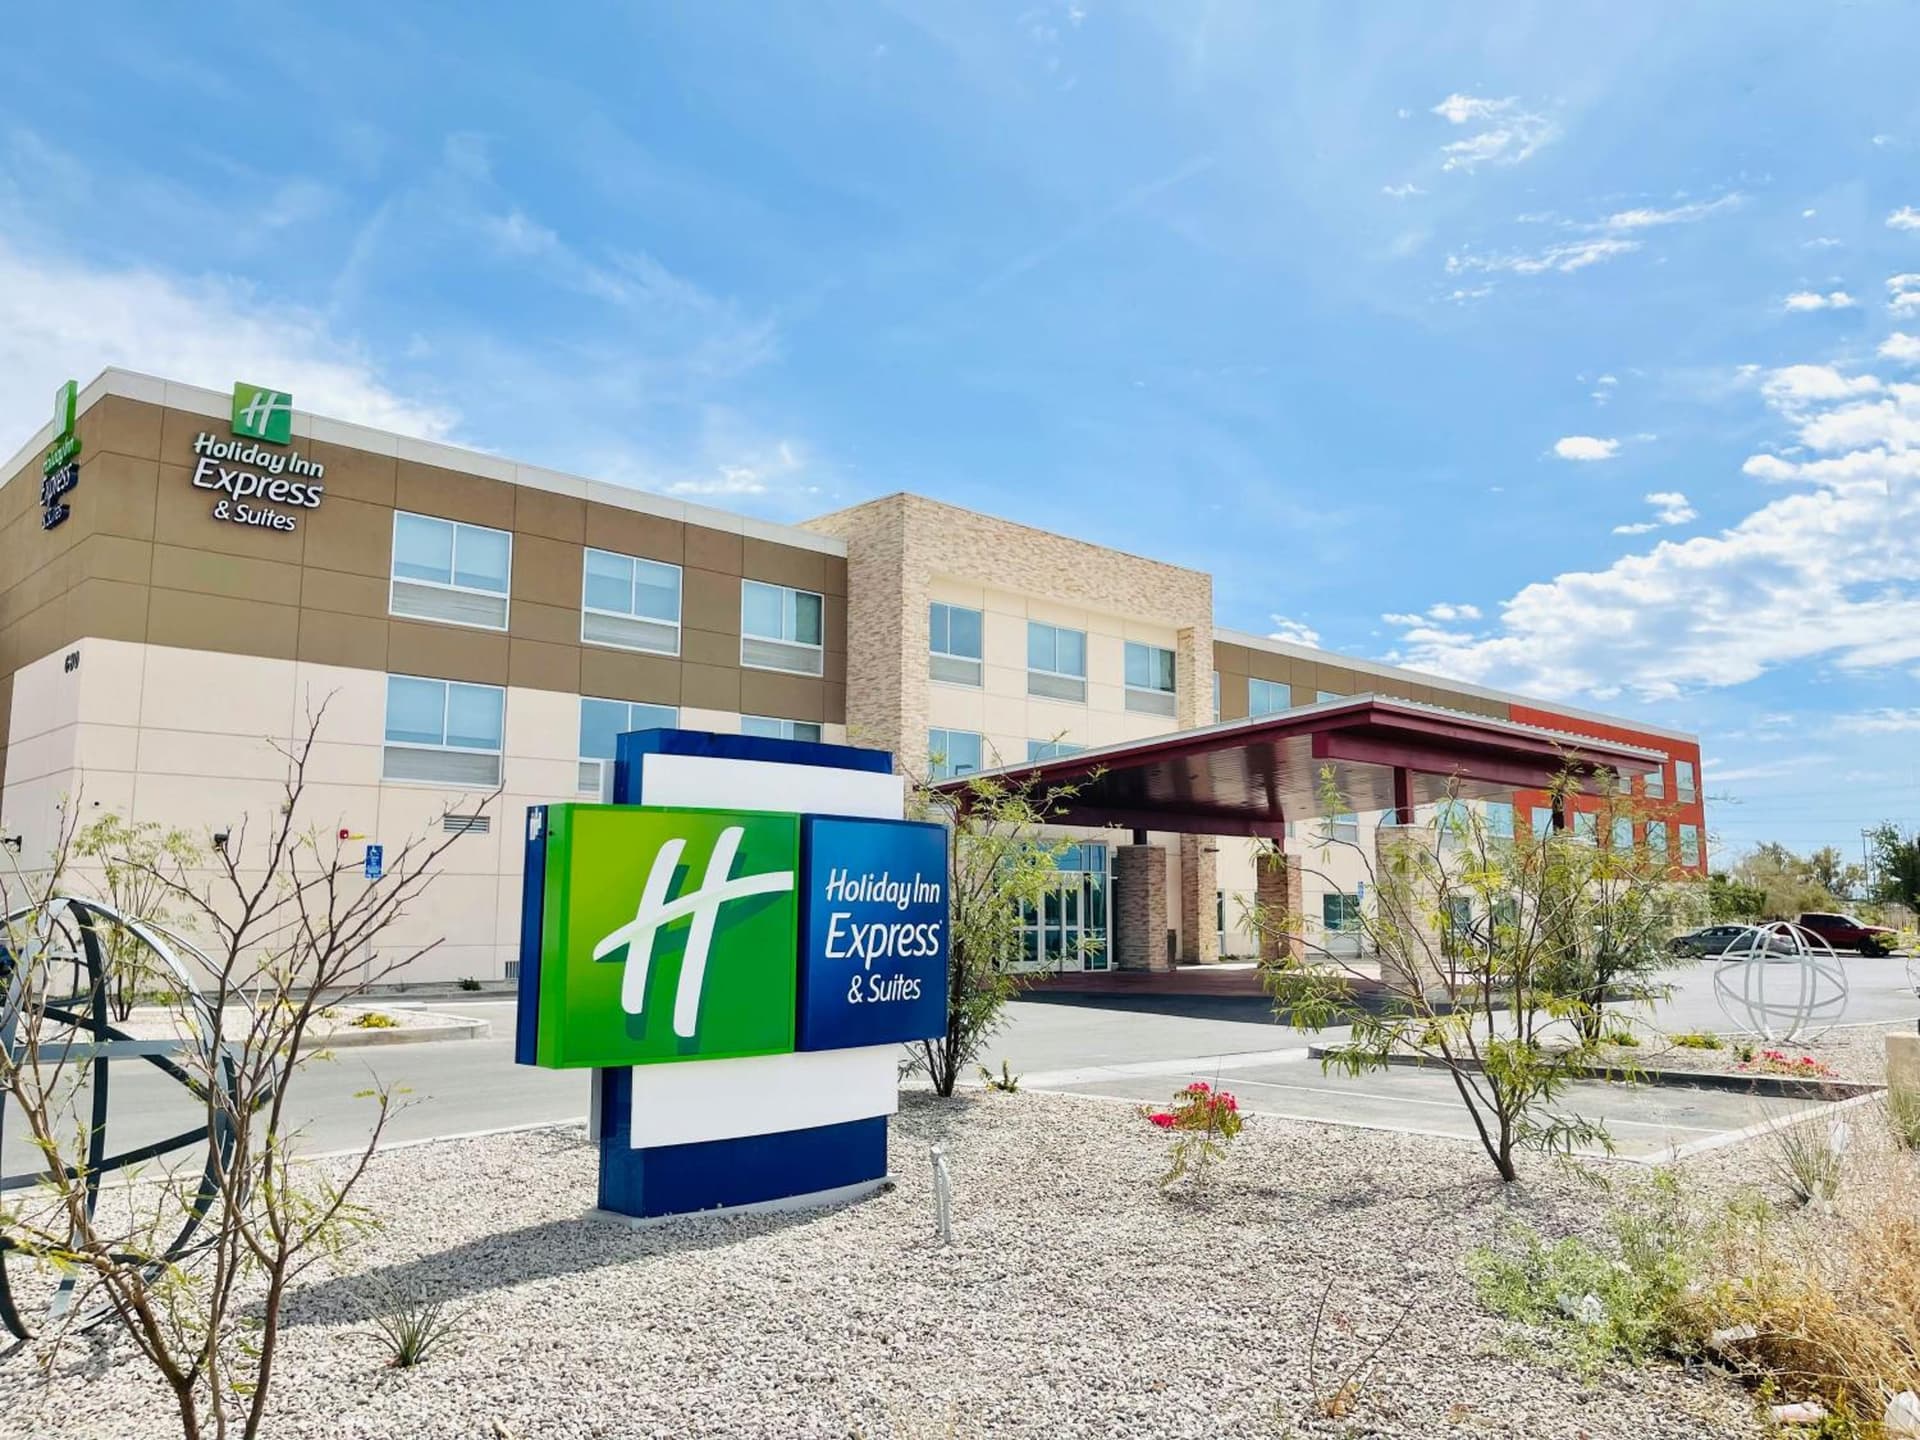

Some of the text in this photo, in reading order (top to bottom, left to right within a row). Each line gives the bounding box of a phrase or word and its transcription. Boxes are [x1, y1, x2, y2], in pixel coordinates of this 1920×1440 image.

[194, 432, 325, 478] Holiday Inn
[193, 457, 324, 508] Express
[214, 500, 297, 531] & Suites
[825, 868, 941, 911] Holiday Inn
[825, 912, 941, 971] Express
[847, 973, 922, 1004] & Suites
